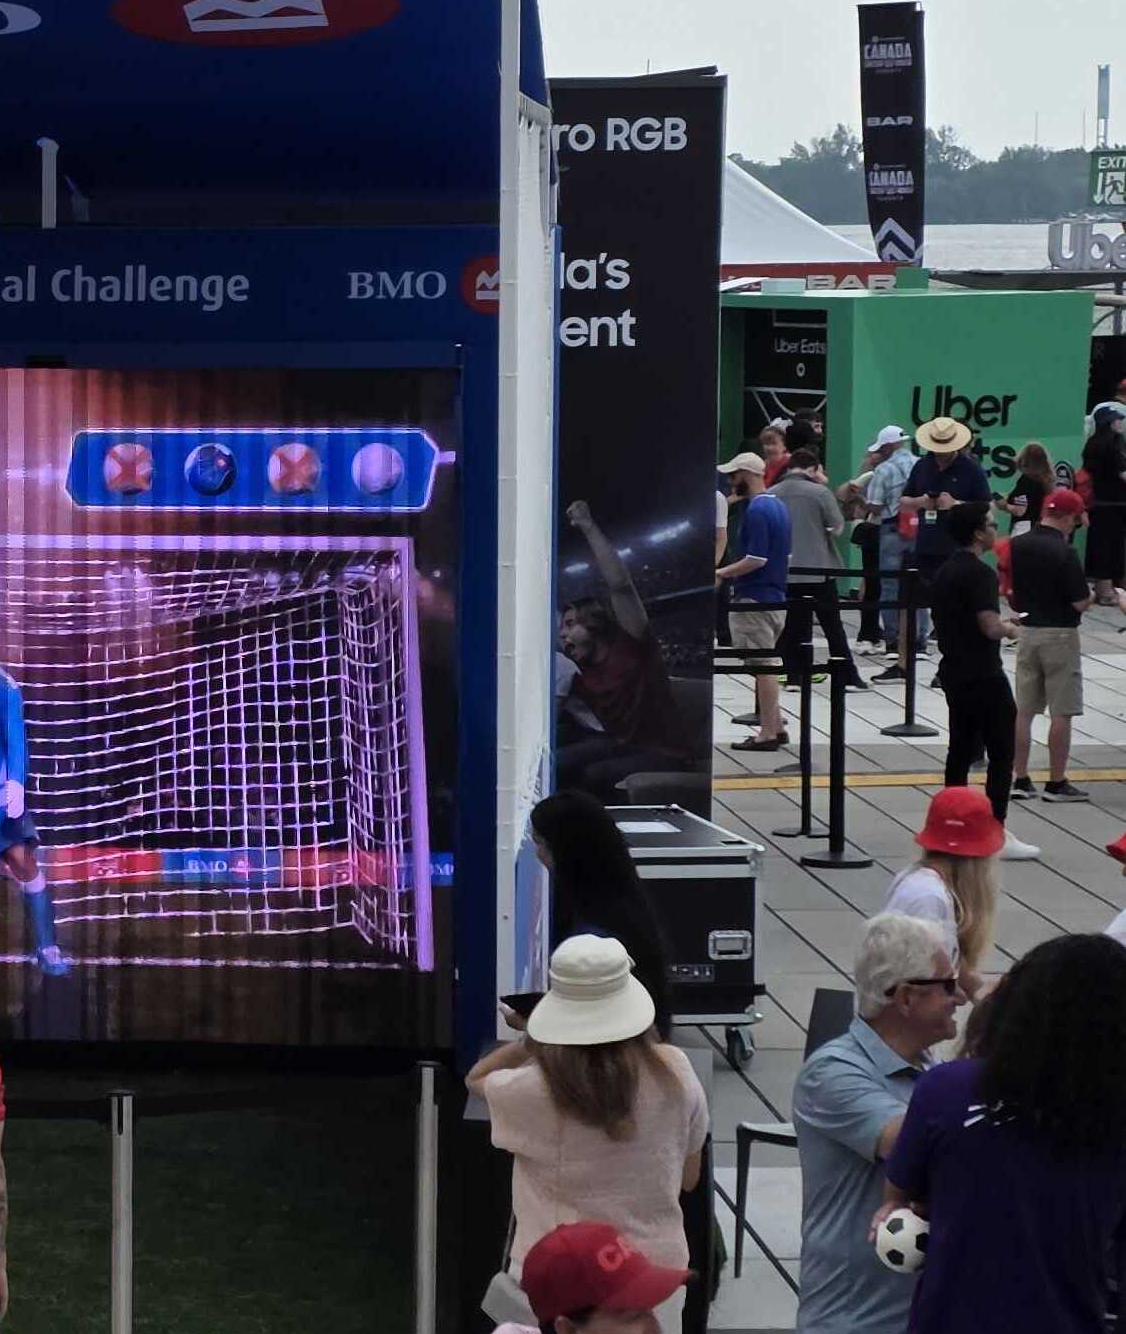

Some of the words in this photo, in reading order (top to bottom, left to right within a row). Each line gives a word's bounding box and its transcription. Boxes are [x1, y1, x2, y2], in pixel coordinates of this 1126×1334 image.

[606, 117, 688, 152] RGB
[866, 115, 914, 126] BAR
[51, 265, 250, 311] Challenge
[348, 270, 447, 300] BMO
[807, 274, 897, 293] BAR
[911, 385, 1018, 427] Uber
